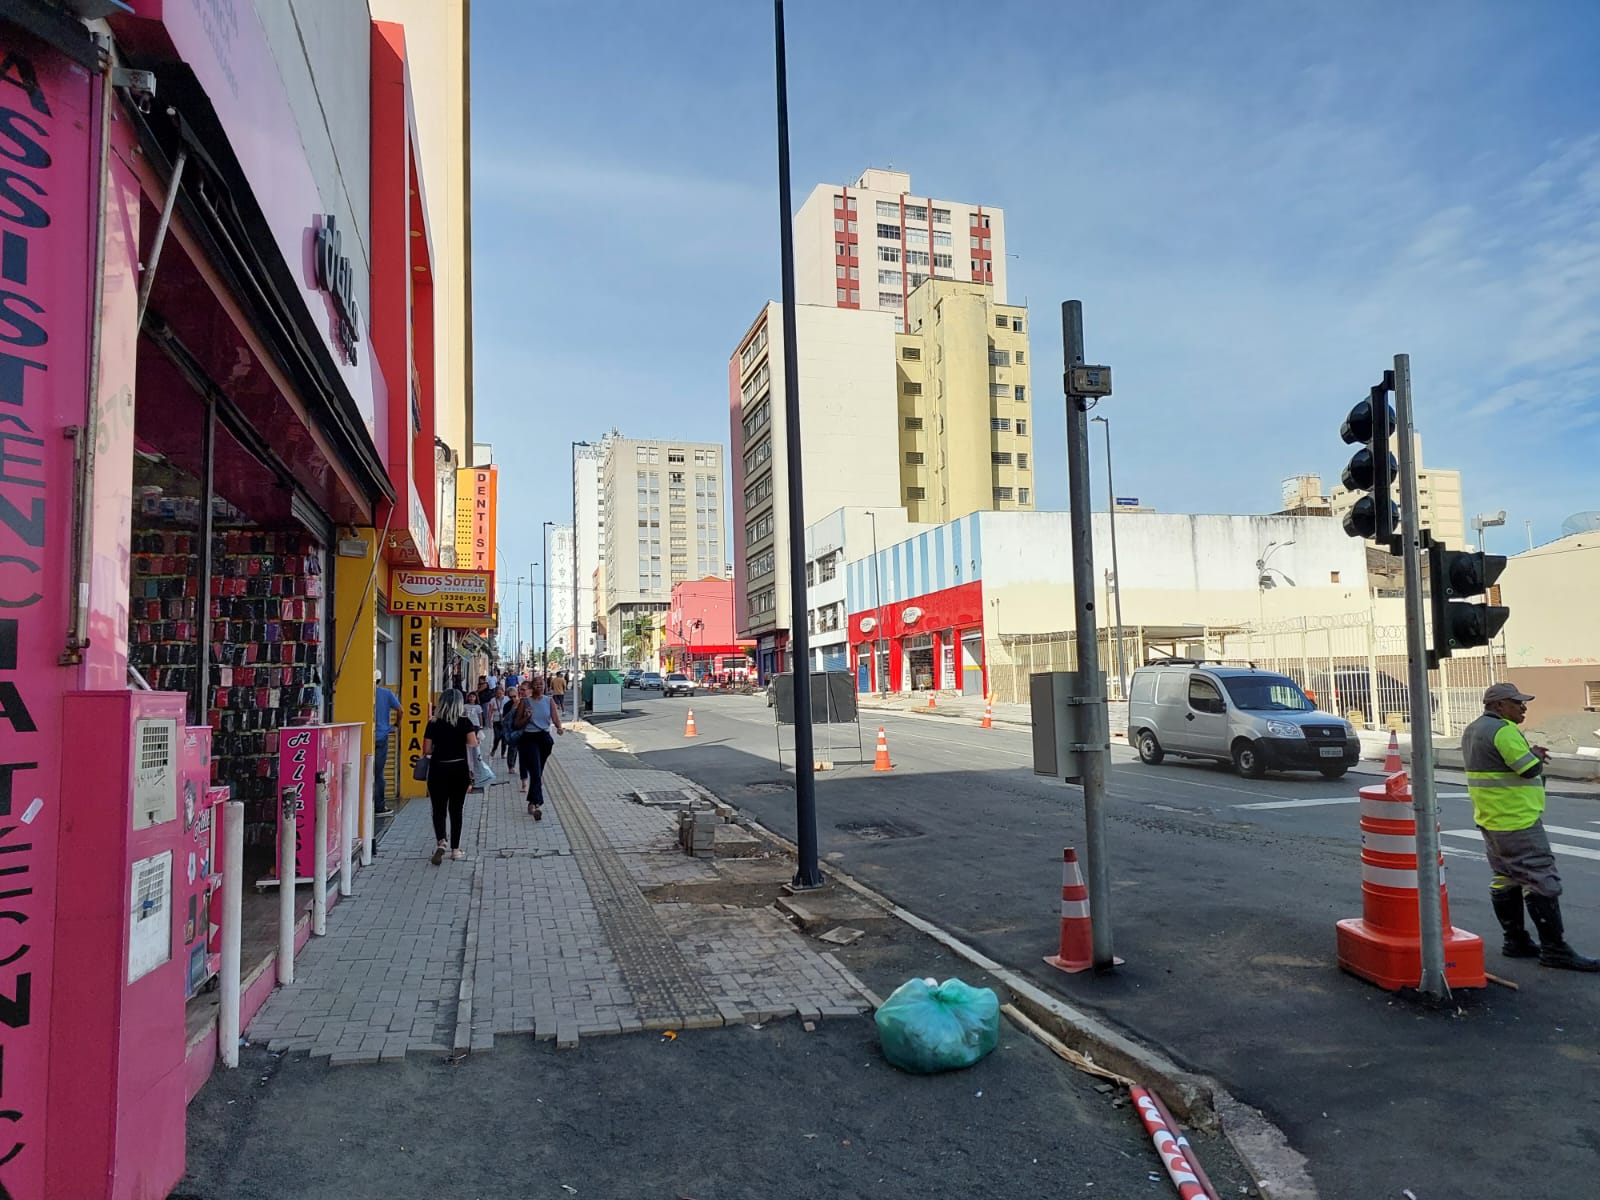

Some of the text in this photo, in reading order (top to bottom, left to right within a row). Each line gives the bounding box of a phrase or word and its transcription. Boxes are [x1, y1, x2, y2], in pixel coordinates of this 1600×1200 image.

[397, 572, 485, 588] Vamos Sorrir
[393, 600, 486, 613] DENTISTAS
[408, 616, 423, 769] DENTISTAS
